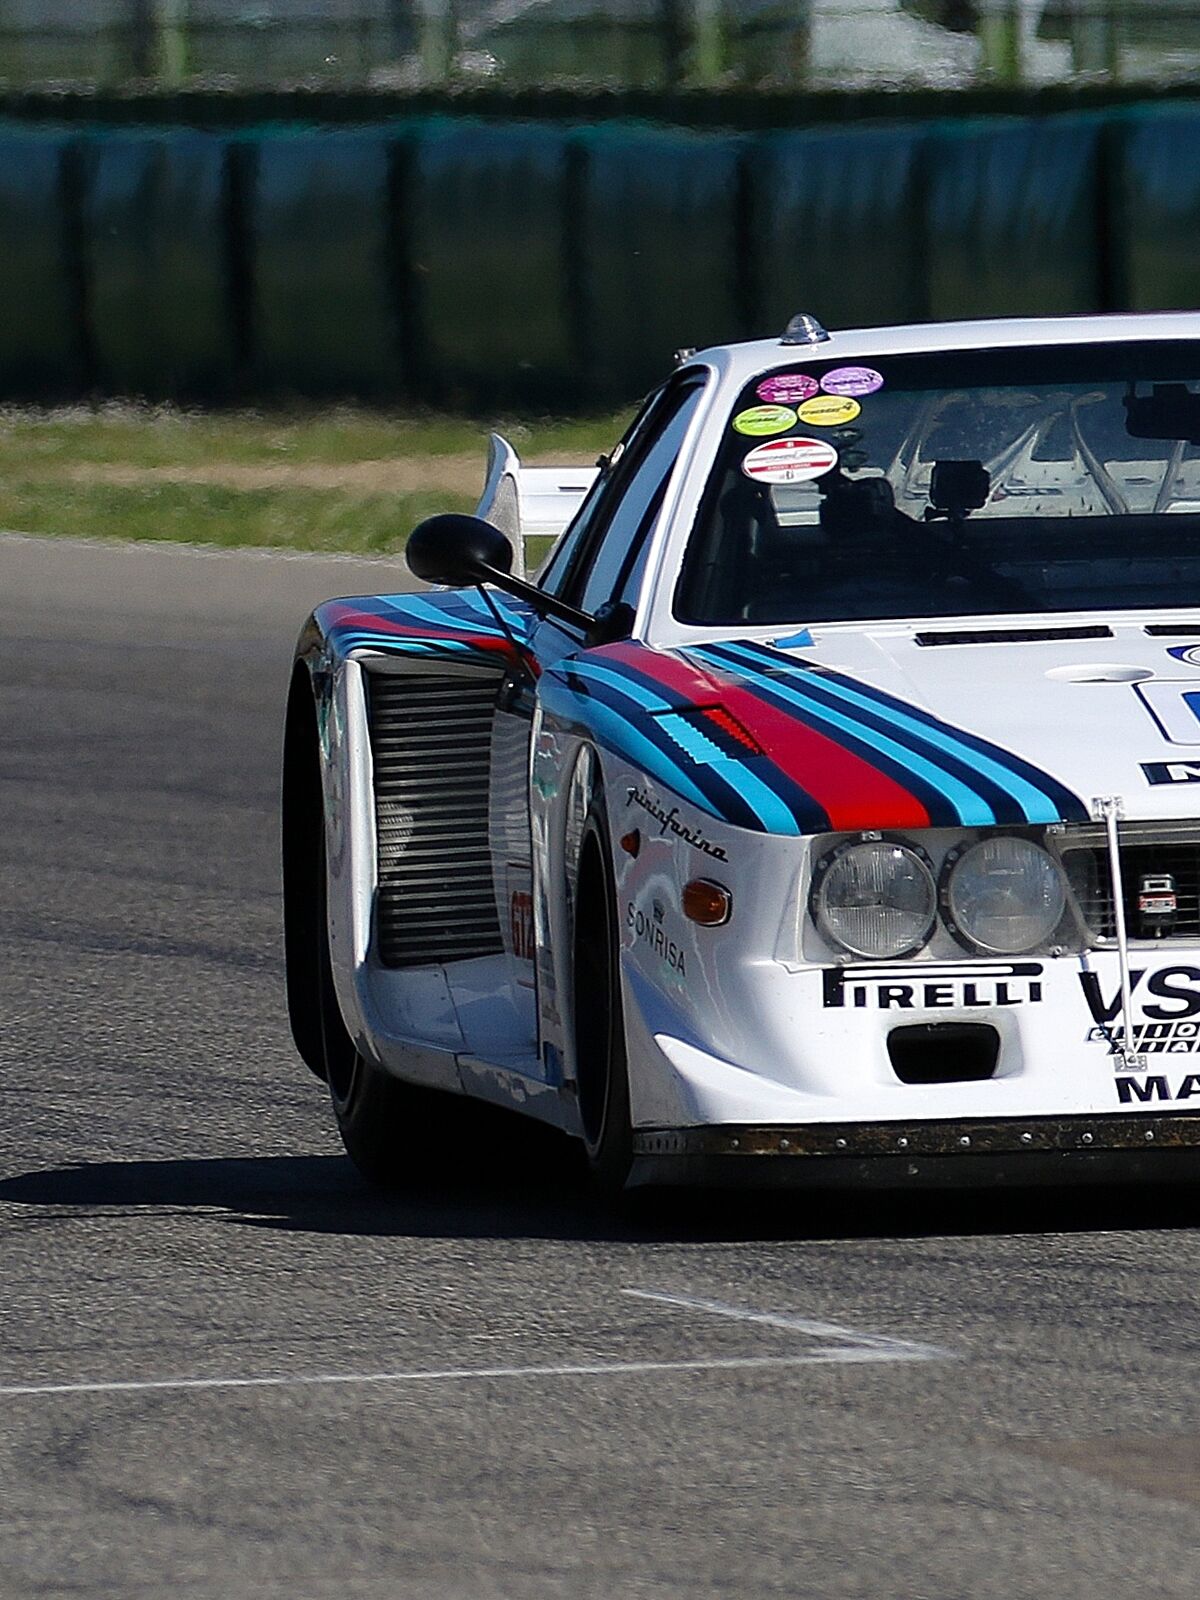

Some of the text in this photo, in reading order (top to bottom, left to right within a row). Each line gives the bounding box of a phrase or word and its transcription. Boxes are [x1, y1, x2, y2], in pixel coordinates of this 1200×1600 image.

[626, 787, 729, 863] pininfarina
[626, 901, 686, 977] SONRISA
[822, 962, 1044, 1009] PIRELLI
